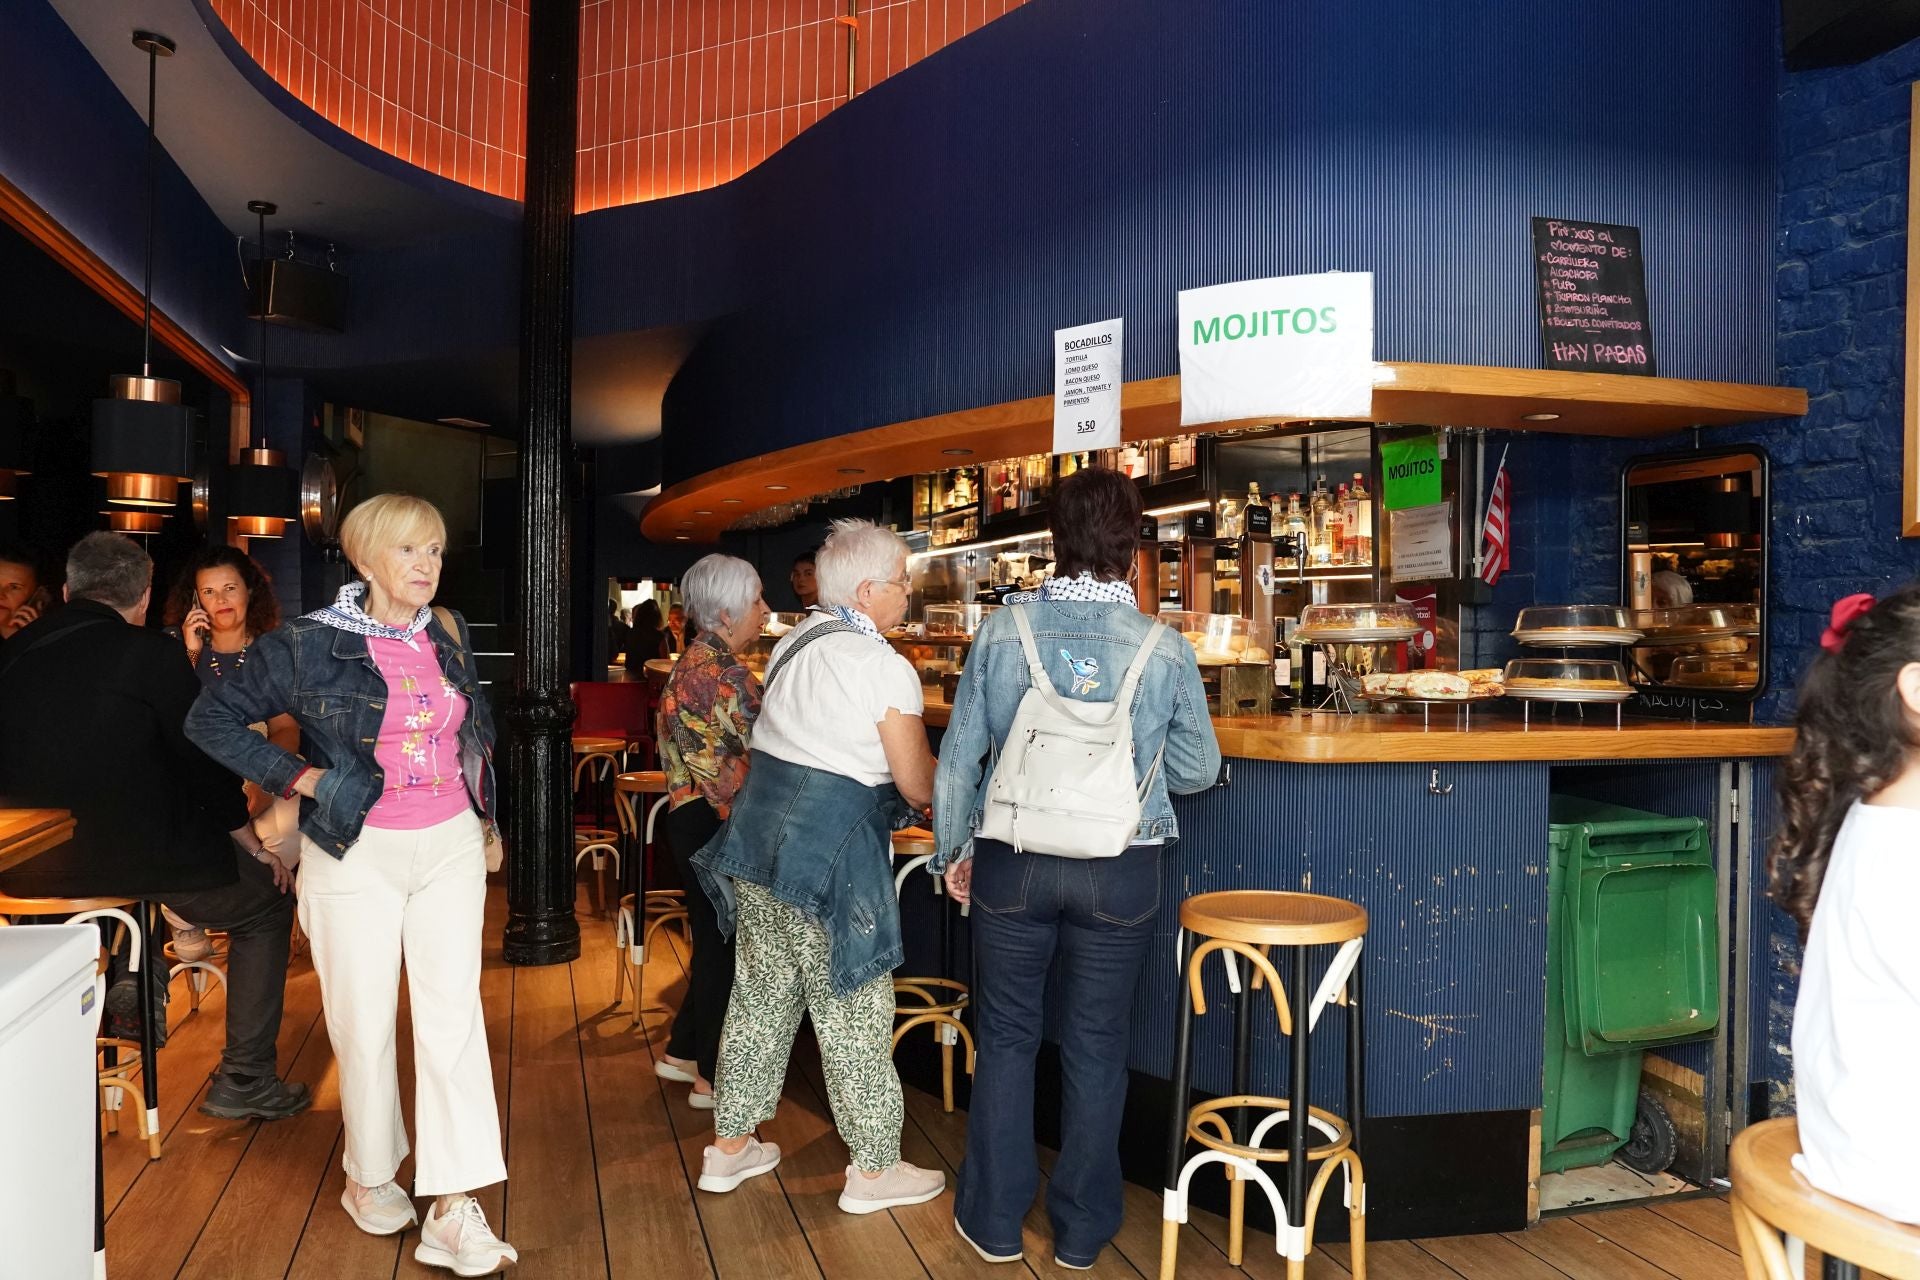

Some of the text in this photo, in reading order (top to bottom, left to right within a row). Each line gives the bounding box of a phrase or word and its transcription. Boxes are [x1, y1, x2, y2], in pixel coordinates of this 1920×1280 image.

[1193, 306, 1337, 345] MOJITOS
[1064, 333, 1112, 351] BOCADILLOS
[1552, 341, 1588, 362] HAY
[1065, 354, 1088, 363] TORTILLA
[1065, 363, 1099, 374] LOMO QUESO
[1065, 373, 1100, 385] BACON QUESO
[1086, 384, 1107, 393] TOMATE
[1063, 397, 1090, 406] PIMIENTOS
[1077, 419, 1096, 432] 5,50
[1388, 458, 1435, 481] MOJITOS
